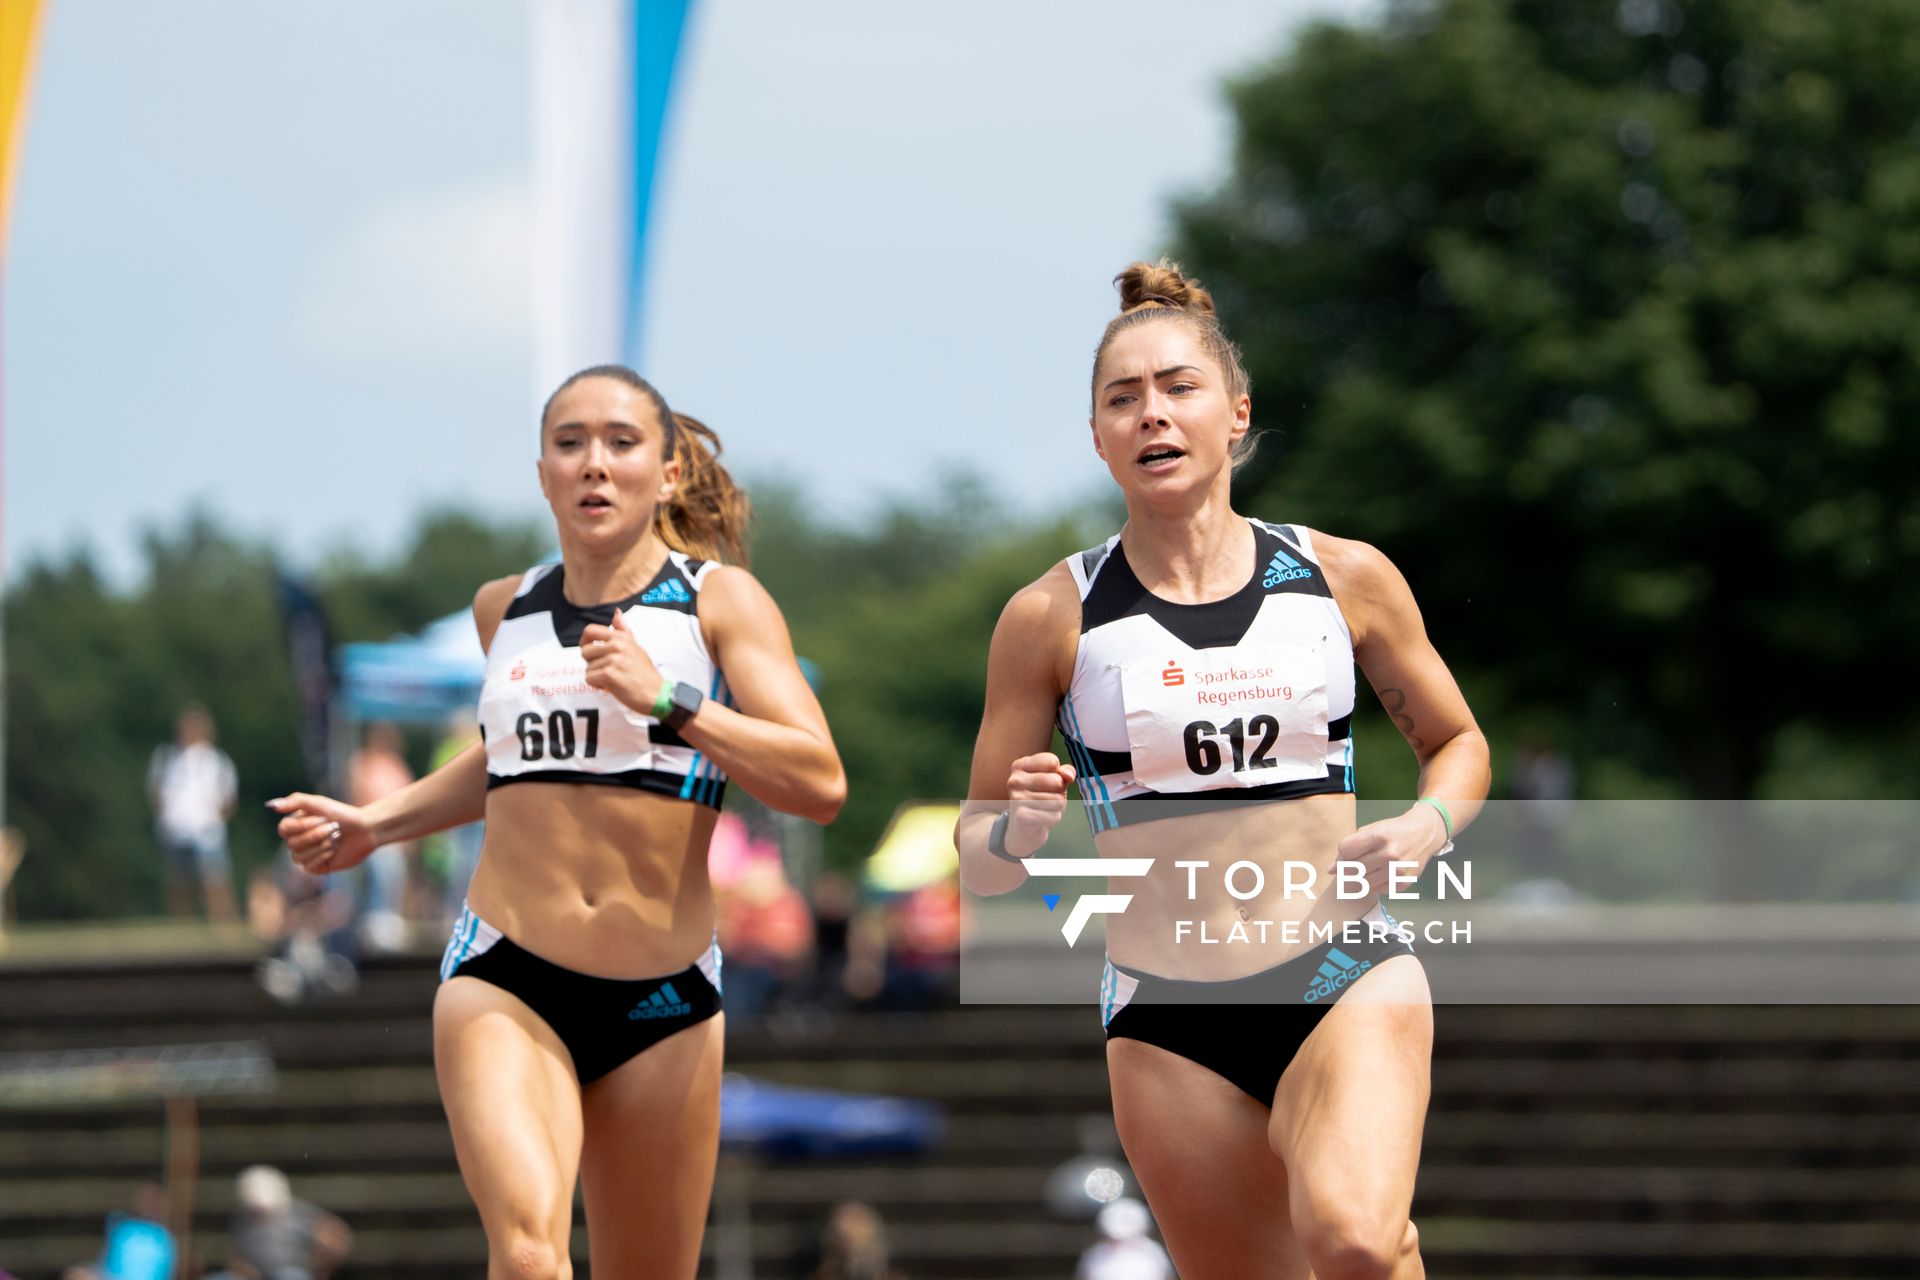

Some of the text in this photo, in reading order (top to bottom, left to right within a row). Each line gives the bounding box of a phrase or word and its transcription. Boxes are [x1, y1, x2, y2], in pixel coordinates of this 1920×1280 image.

[1262, 567, 1312, 589] adidas
[1195, 667, 1274, 685] Sparkasse
[1197, 685, 1292, 707] Regensburg
[516, 708, 599, 761] 607
[1183, 714, 1280, 776] 612
[1303, 957, 1372, 1004] adidas
[628, 1002, 692, 1021] adidas
